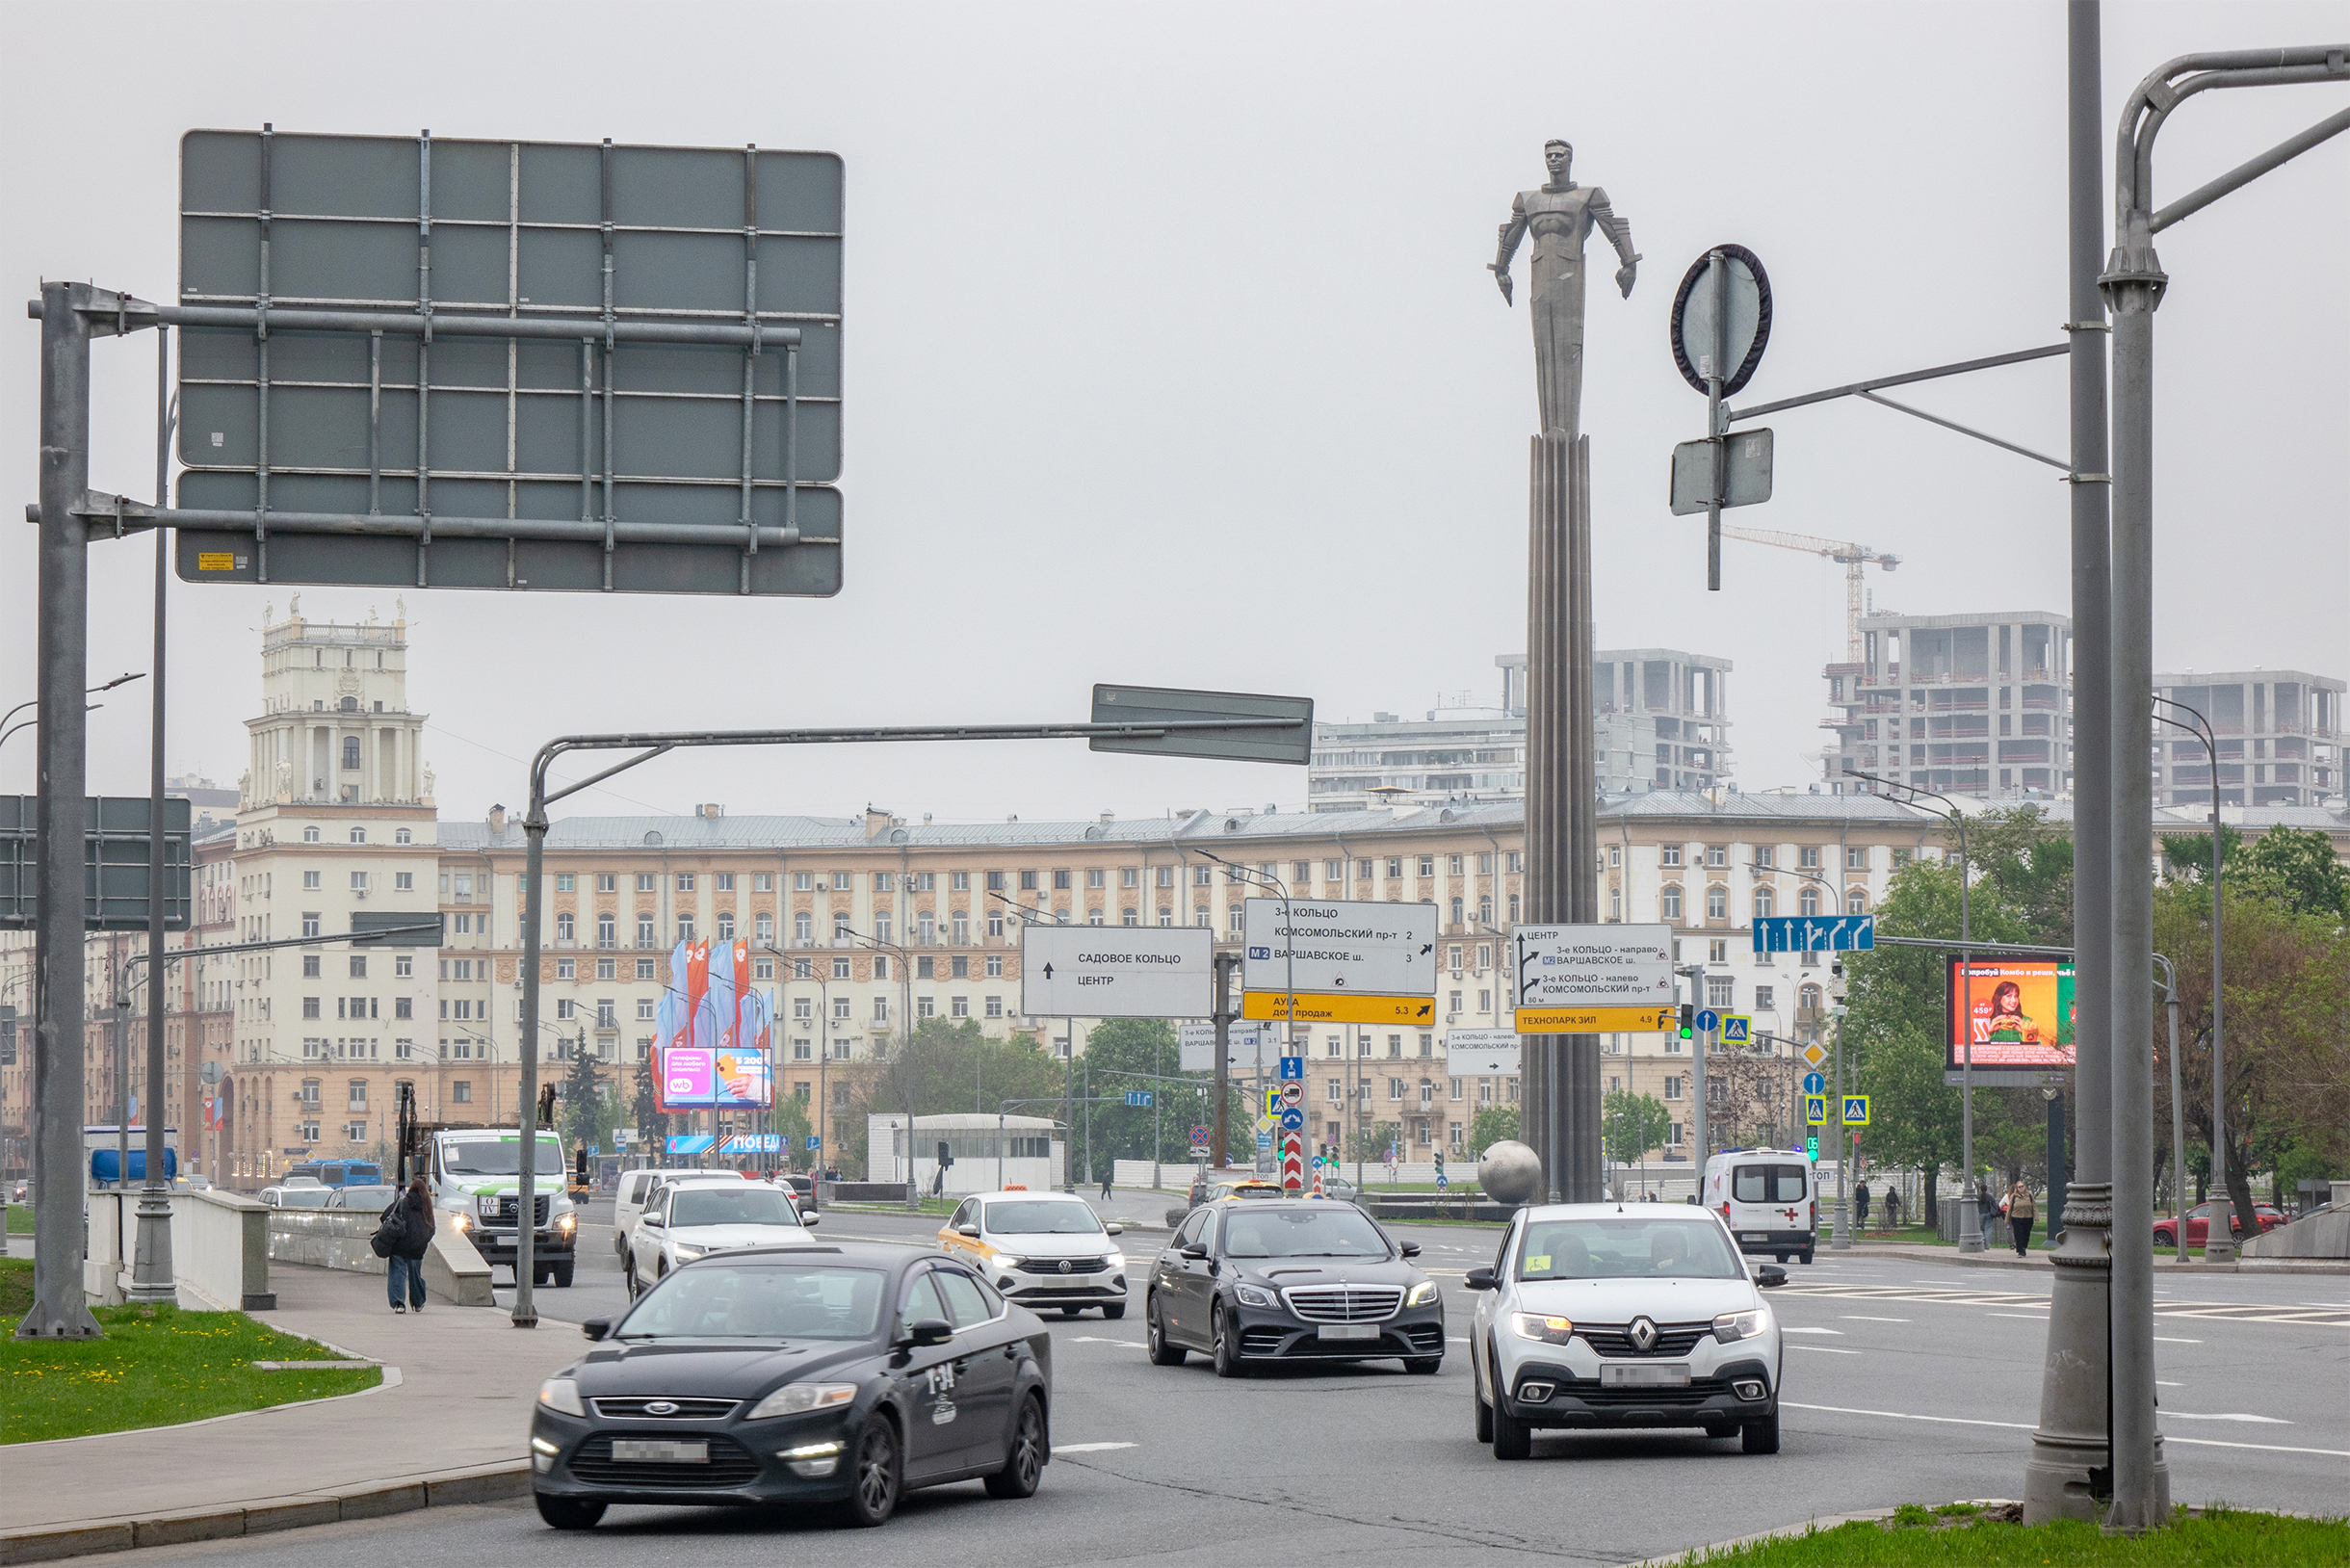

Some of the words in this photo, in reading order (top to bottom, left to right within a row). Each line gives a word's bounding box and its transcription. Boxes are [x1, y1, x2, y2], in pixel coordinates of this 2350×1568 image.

[1292, 907, 1339, 919] КОЛЬЦО
[1274, 927, 1373, 939] КОМСОМОЛЬСКИЙ
[1375, 931, 1397, 941] пр-т
[1406, 931, 1413, 940] 2
[1528, 931, 1559, 941] ЦЕНТР
[1556, 946, 1571, 954] 3-е
[1572, 946, 1612, 954] КОЛЬЦО
[1620, 946, 1658, 954] направо
[1078, 954, 1132, 964] САДОВОЕ
[1136, 954, 1182, 965] КОЛЬЦО
[1274, 950, 1350, 961] ВАРШАВСКОЕ
[1352, 954, 1365, 962] ш.
[1405, 954, 1412, 963] 3
[1078, 976, 1114, 986] ЦЕНТР
[1558, 975, 1598, 983] КОЛЬЦО
[1542, 984, 1630, 994] КОМСОМОЛЬСКИЙ
[1632, 985, 1651, 994] пр-т
[1295, 1009, 1333, 1018] продаж
[1395, 1006, 1409, 1015] 5.3
[1523, 1016, 1577, 1025] ТЕХНОПАРК
[672, 1080, 690, 1089] wb
[1812, 1171, 1830, 1180] ТОП
